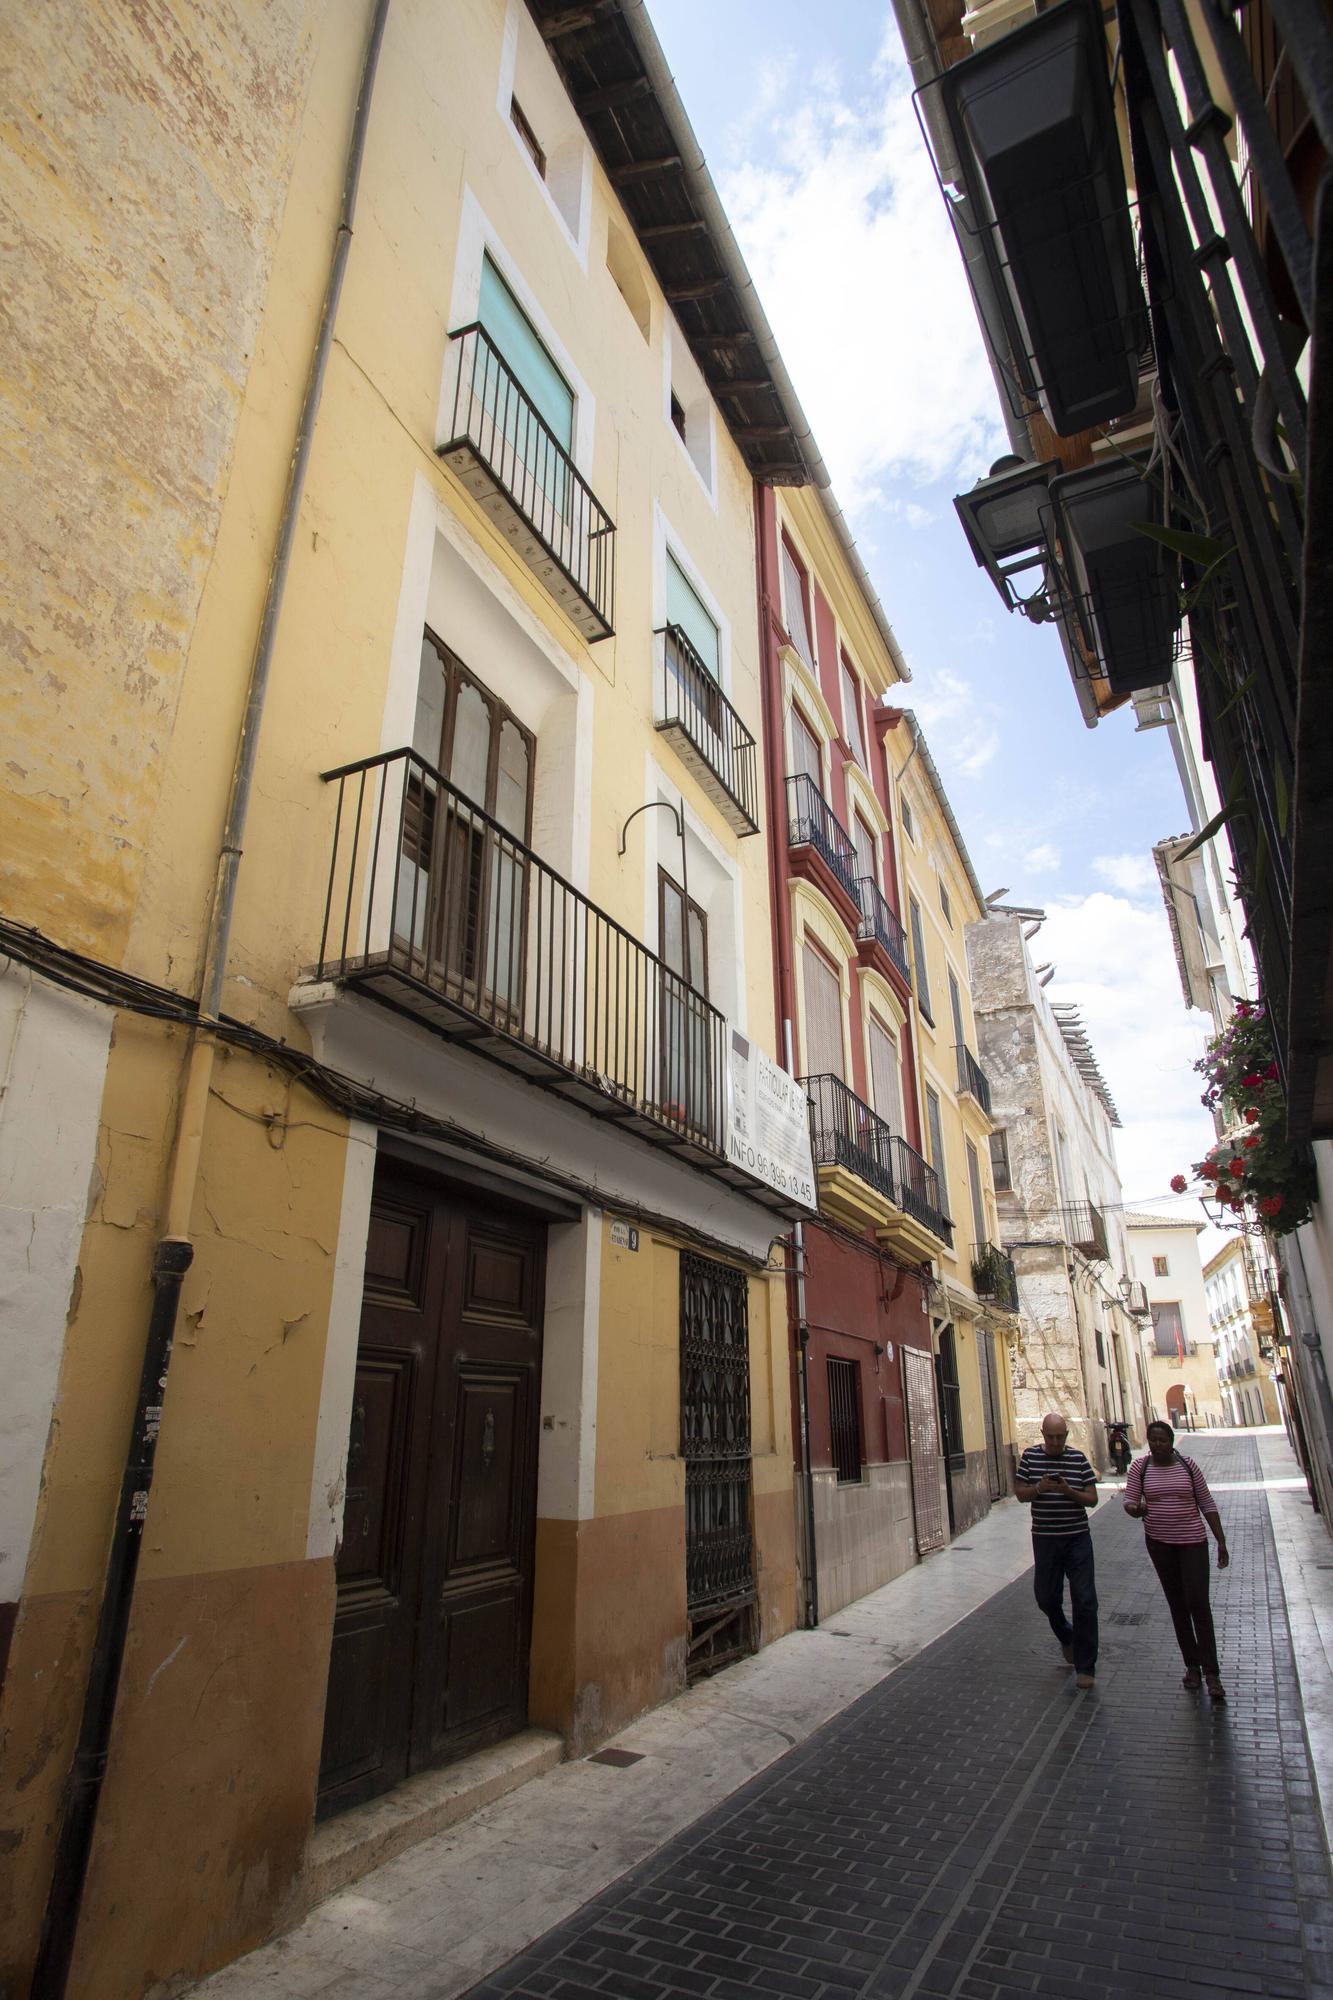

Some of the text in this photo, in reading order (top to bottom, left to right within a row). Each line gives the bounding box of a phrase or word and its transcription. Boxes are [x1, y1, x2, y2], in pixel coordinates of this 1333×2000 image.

[730, 1134, 812, 1202] INFO 96 395 13 45
[631, 1231, 637, 1249] 9
